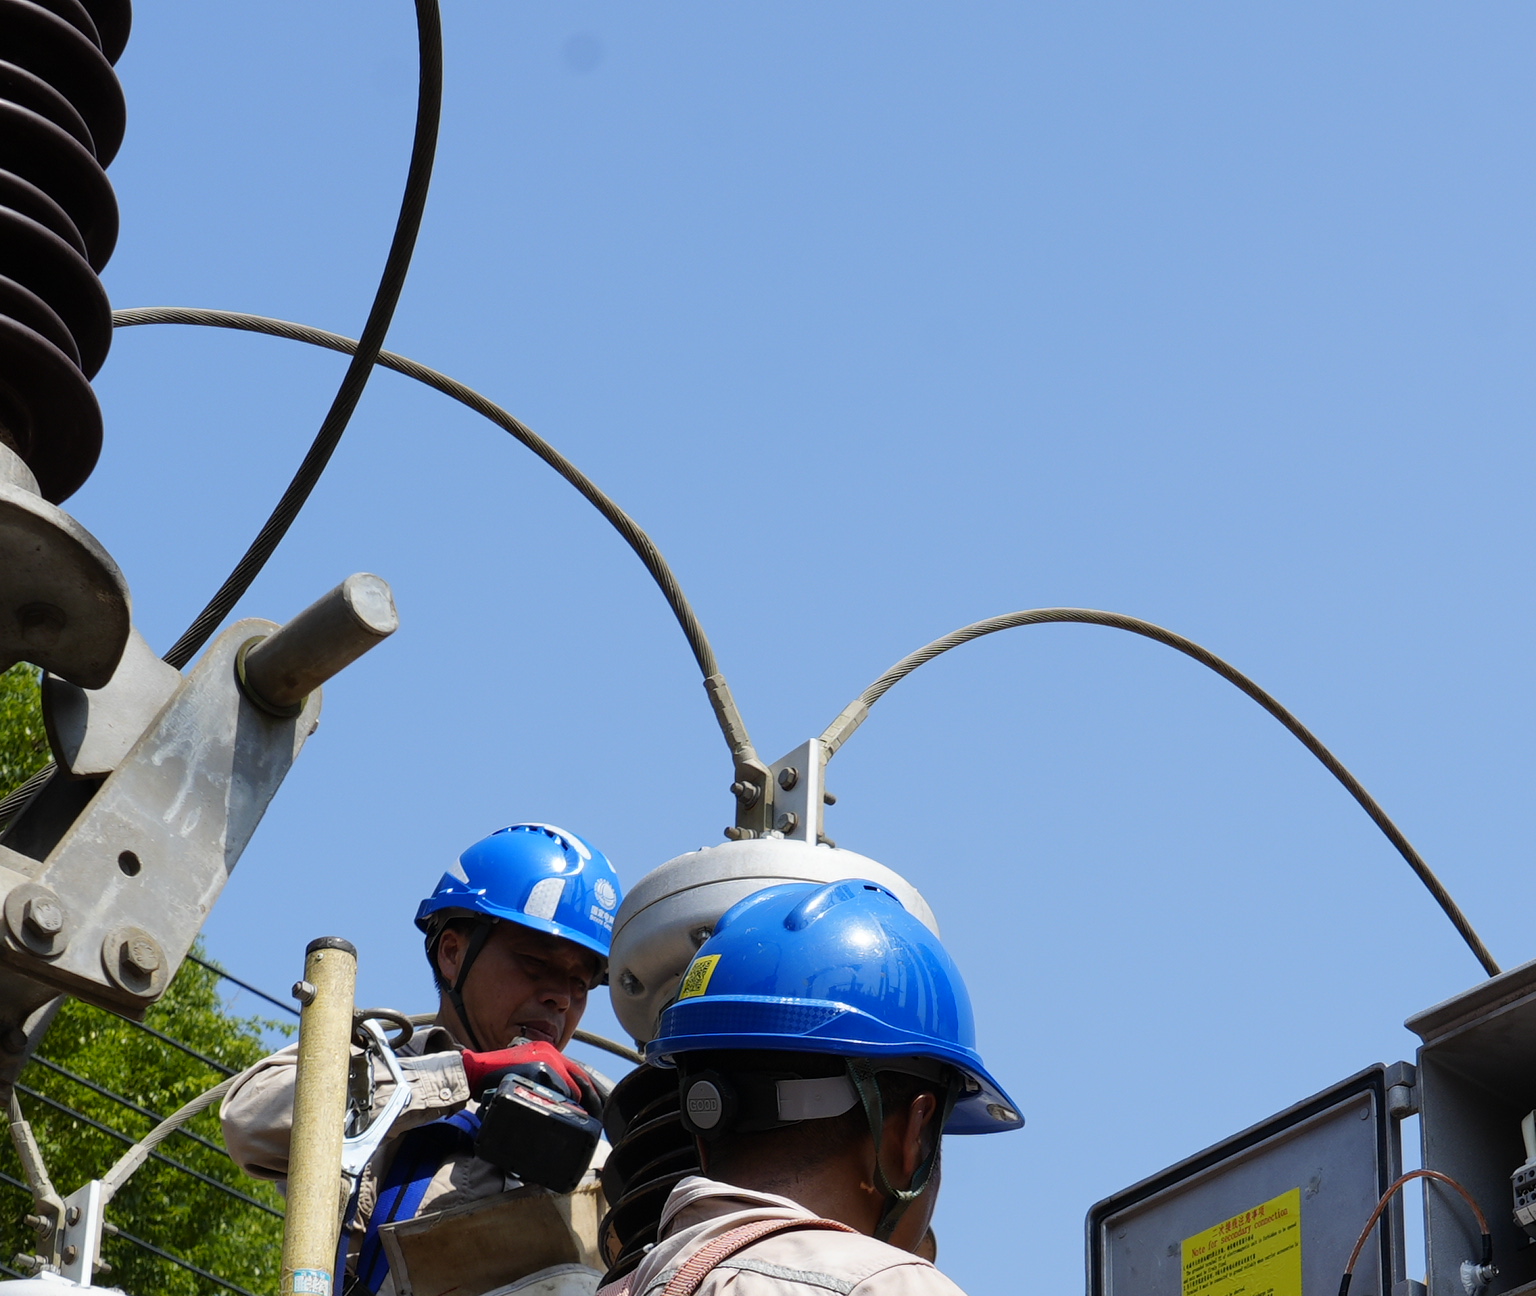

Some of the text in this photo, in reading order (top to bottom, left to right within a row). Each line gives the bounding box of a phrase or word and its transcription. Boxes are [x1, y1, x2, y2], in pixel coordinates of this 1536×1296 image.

[689, 1099, 718, 1111] GOOD
[1192, 1246, 1206, 1258] Note
[1208, 1239, 1218, 1250] for
[1221, 1225, 1252, 1244] secondary
[1254, 1208, 1289, 1229] connection
